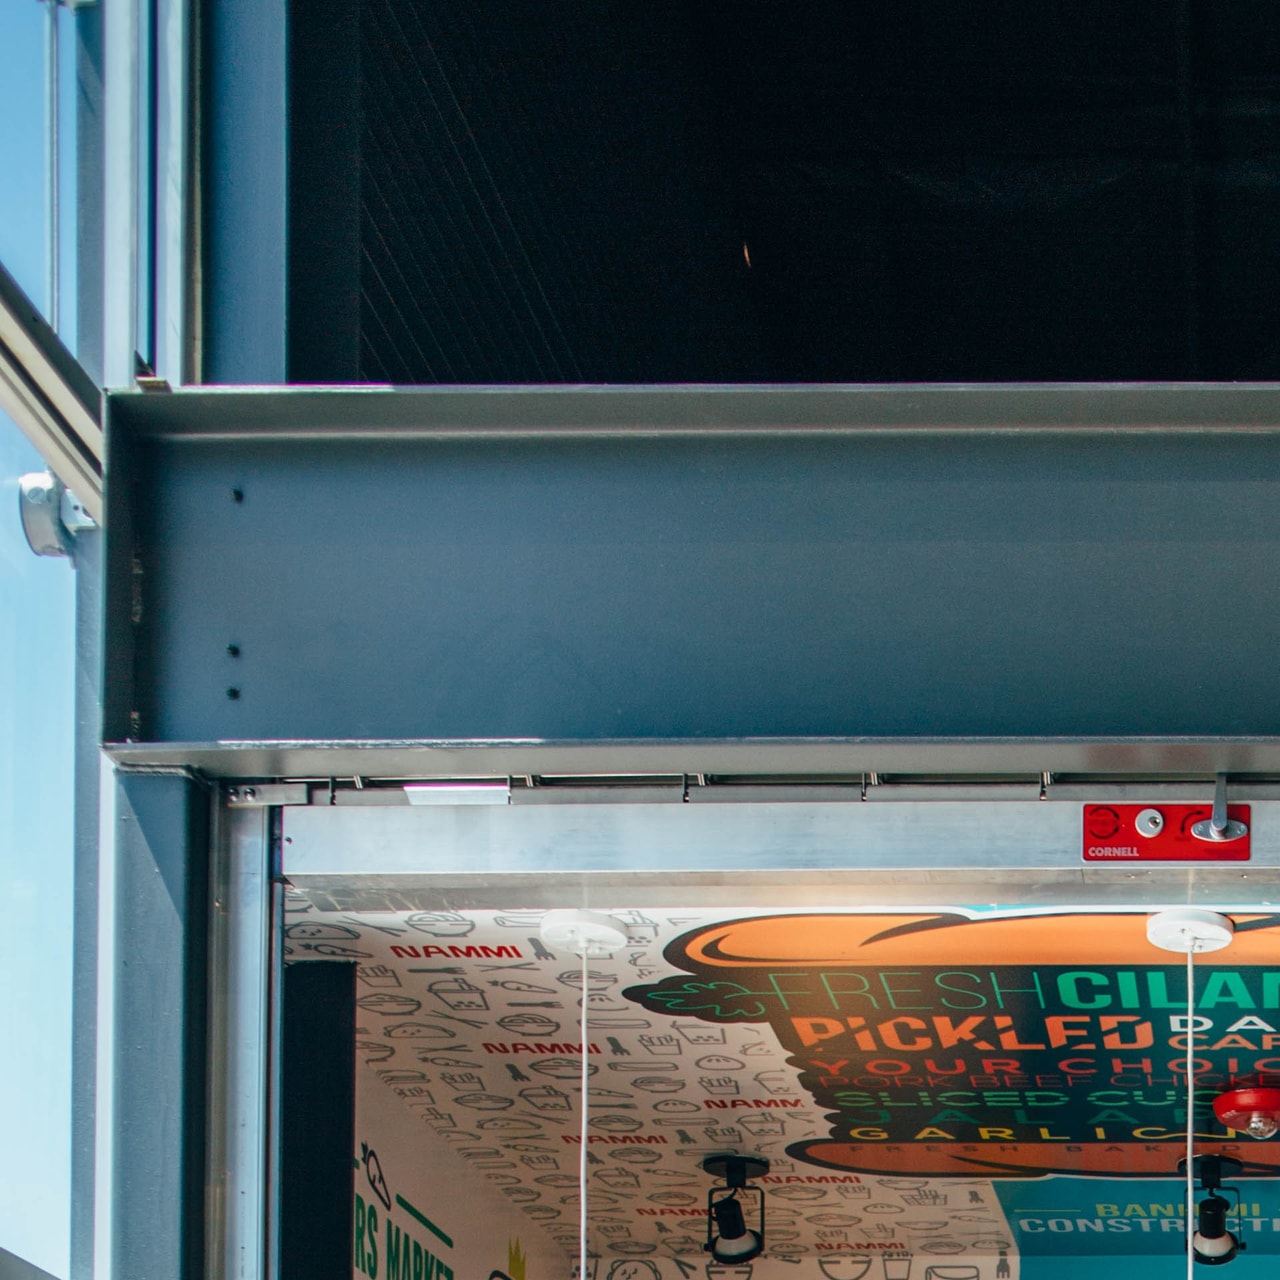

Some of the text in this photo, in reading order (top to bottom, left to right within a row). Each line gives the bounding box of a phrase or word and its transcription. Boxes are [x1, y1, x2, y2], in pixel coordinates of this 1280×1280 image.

[1088, 846, 1139, 857] CORNELL
[391, 945, 523, 959] NAMMI
[768, 971, 1046, 1010] FRESH
[790, 1015, 1155, 1052] PICKLED
[810, 1058, 1022, 1076] YOUR
[818, 1074, 958, 1089] PORK
[969, 1074, 1094, 1089] BEEF
[834, 1091, 1070, 1108] SLICED
[761, 1174, 862, 1185] NAMMI
[814, 1241, 906, 1250] NAMMI
